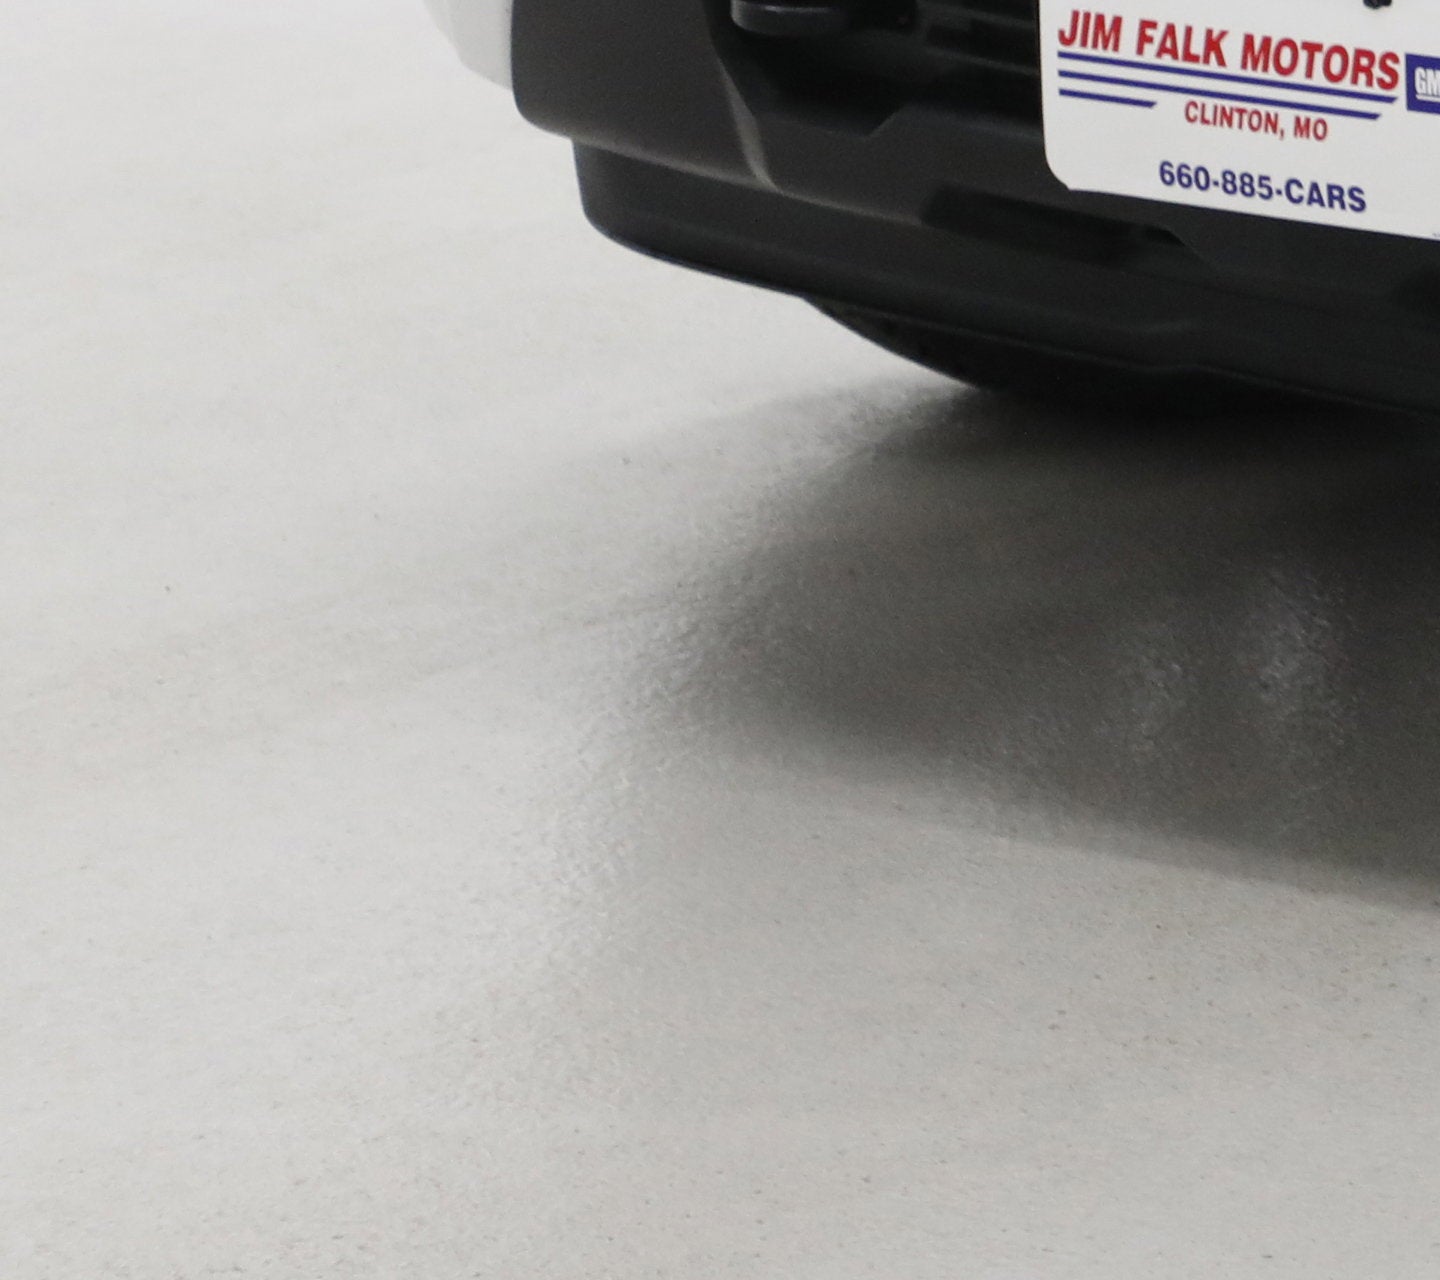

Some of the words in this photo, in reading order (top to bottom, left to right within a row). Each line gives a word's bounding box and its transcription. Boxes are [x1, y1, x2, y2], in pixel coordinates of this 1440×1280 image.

[1057, 9, 1122, 53] JIM
[1135, 18, 1229, 68] FALK
[1240, 32, 1401, 92] MOTORS
[1184, 100, 1286, 140] CLINTON,
[1293, 116, 1329, 142] MO
[1158, 160, 1368, 214] 660-885-CARS
